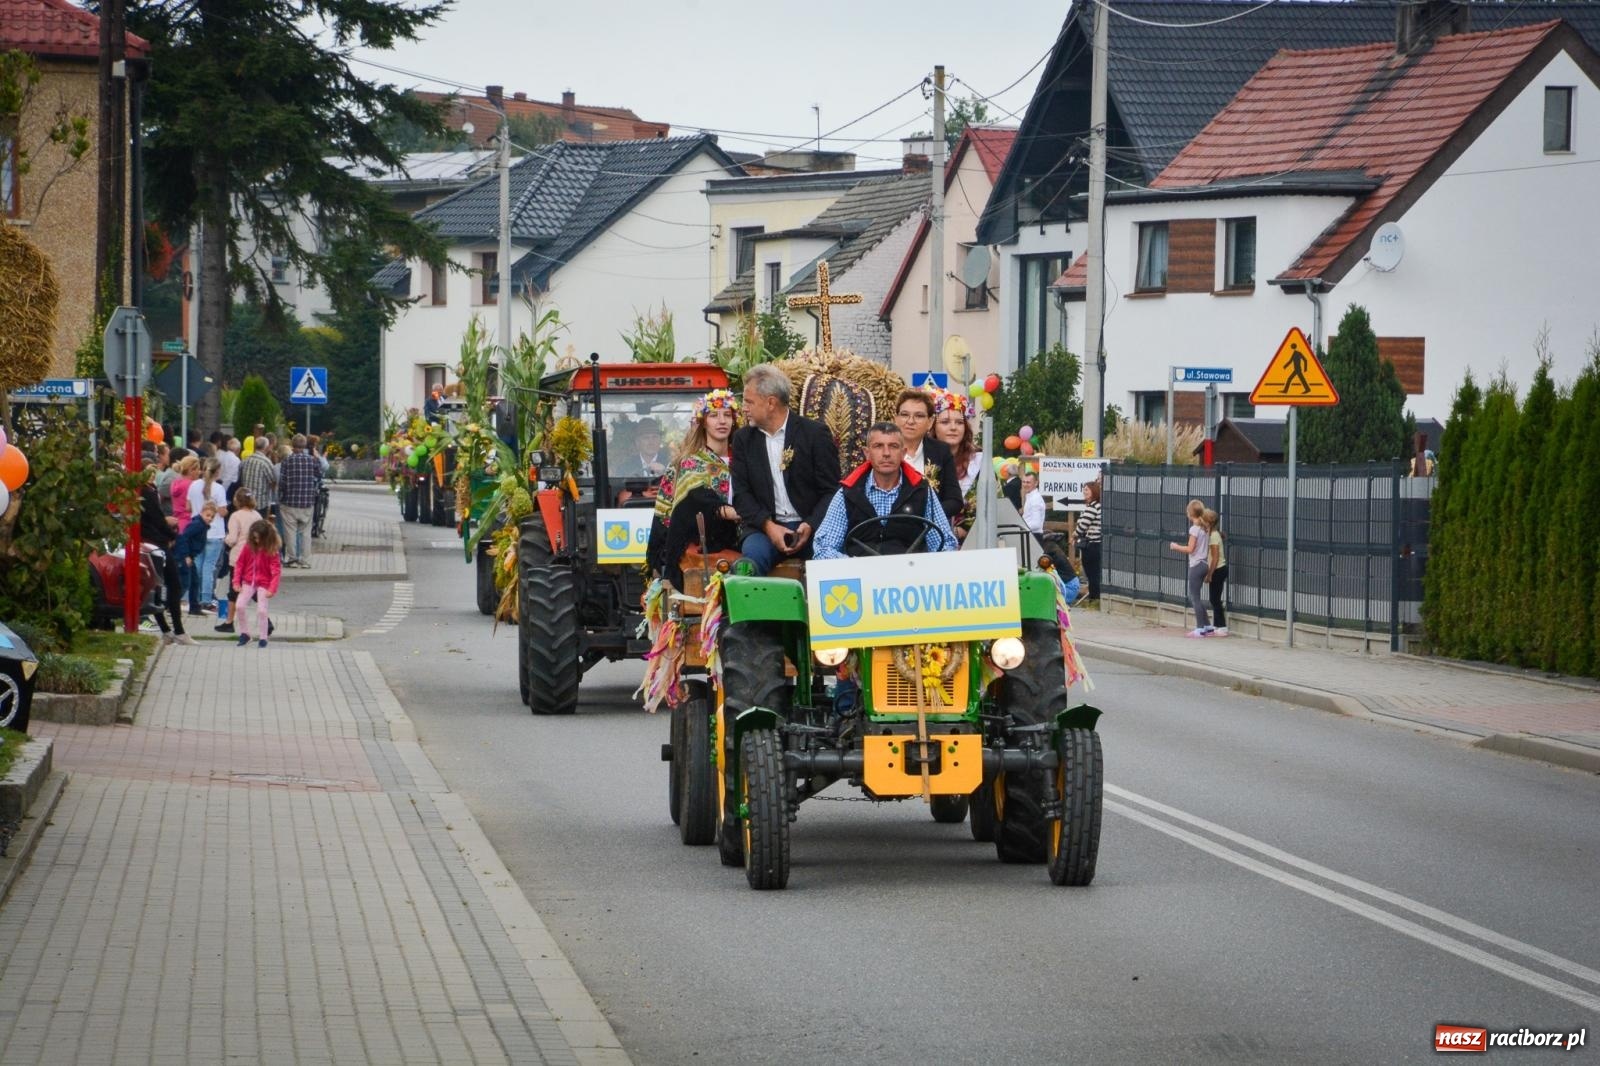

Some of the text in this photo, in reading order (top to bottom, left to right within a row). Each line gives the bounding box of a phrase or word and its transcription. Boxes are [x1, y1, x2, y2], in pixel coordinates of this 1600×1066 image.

[1380, 233, 1399, 243] nc+
[614, 377, 686, 387] URSUS
[1043, 482, 1078, 493] PARKING
[872, 580, 1006, 616] KROWIARKI
